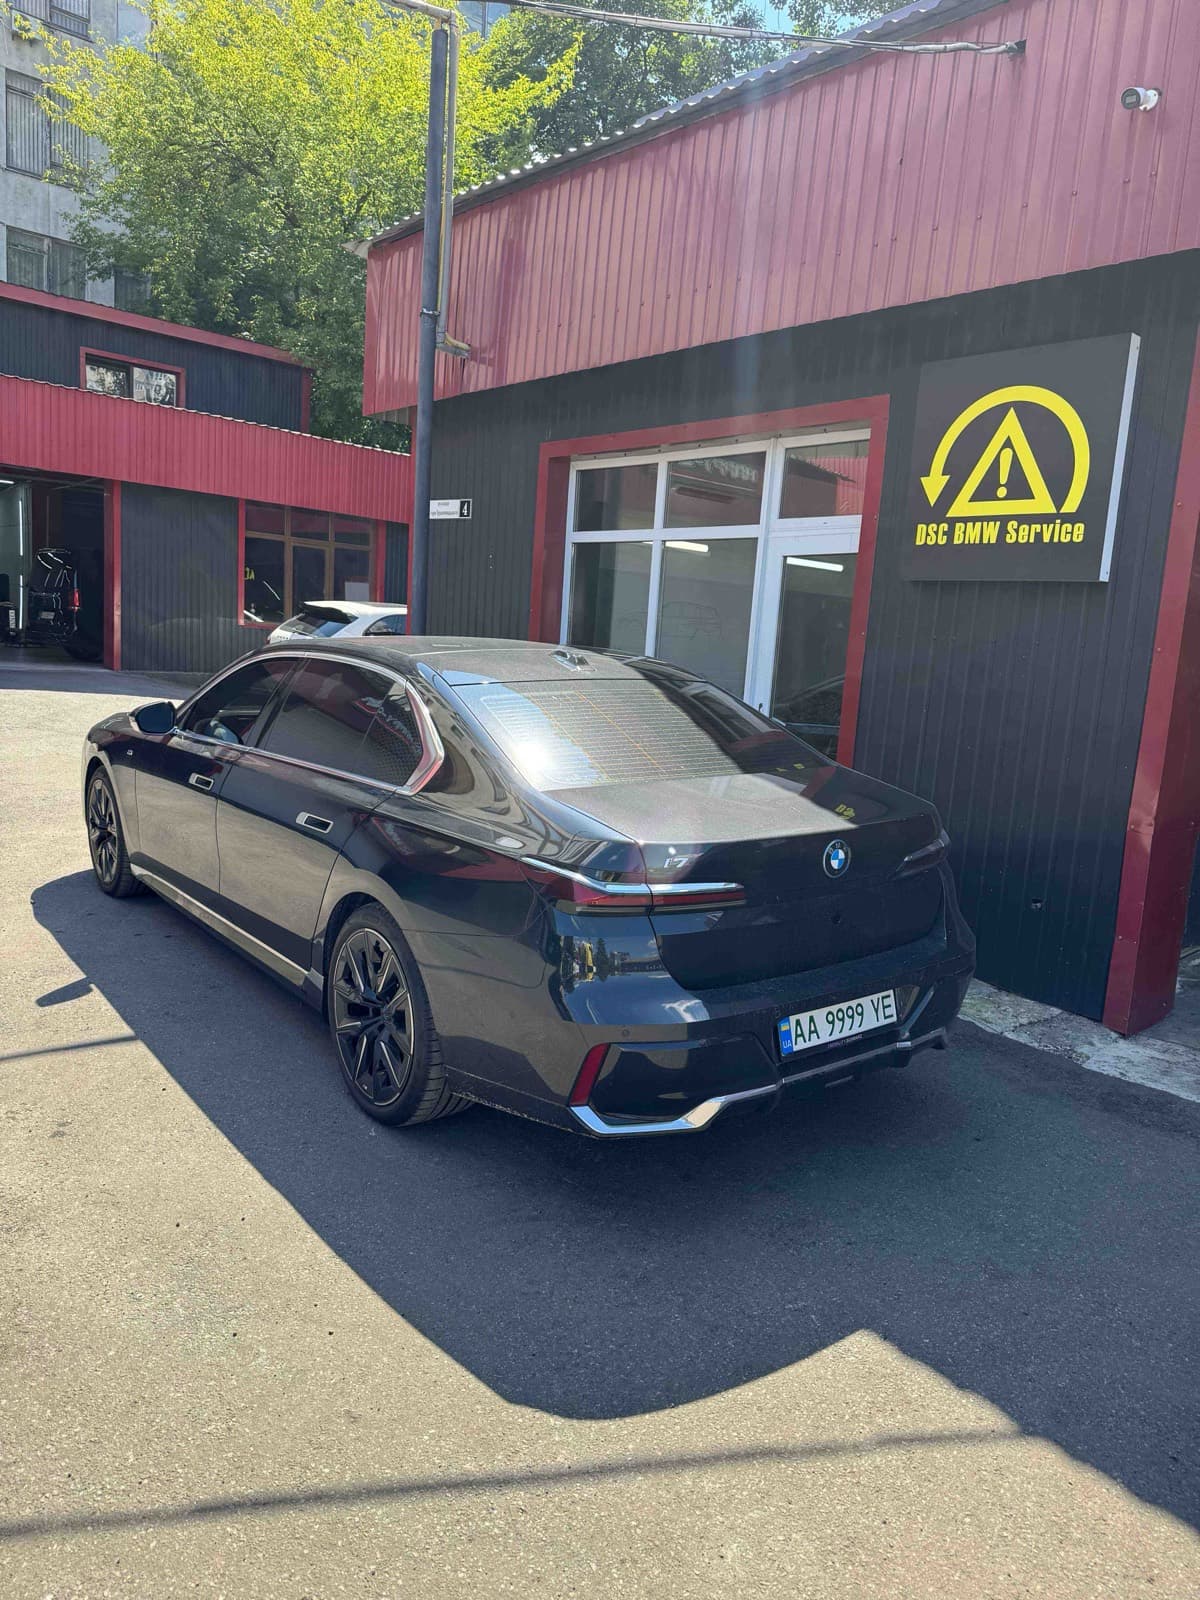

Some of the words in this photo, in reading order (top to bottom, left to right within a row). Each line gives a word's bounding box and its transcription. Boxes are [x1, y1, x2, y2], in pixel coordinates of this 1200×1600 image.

[462, 501, 468, 515] 4
[915, 523, 949, 545] DSC
[953, 521, 1000, 544] BMW
[1005, 520, 1085, 544] Service
[794, 1015, 820, 1046] AA
[826, 1003, 864, 1037] 9999
[871, 994, 894, 1022] YE
[782, 1040, 792, 1049] UA
